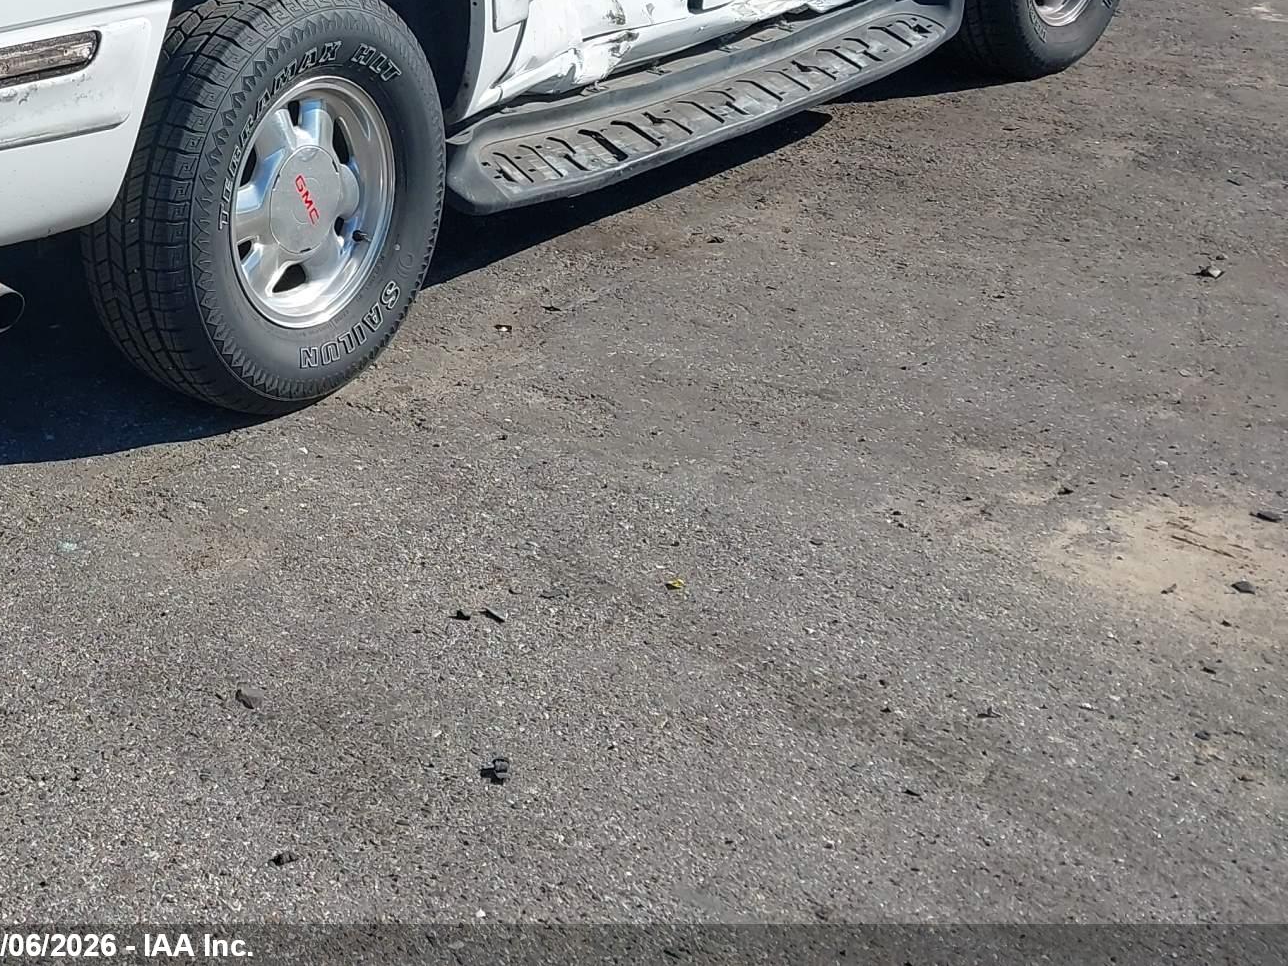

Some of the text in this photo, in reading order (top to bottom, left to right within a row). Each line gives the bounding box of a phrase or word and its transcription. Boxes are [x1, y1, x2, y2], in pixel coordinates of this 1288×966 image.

[350, 43, 402, 82] HLT
[294, 174, 321, 226] GMC
[300, 280, 401, 369] SAILUN
